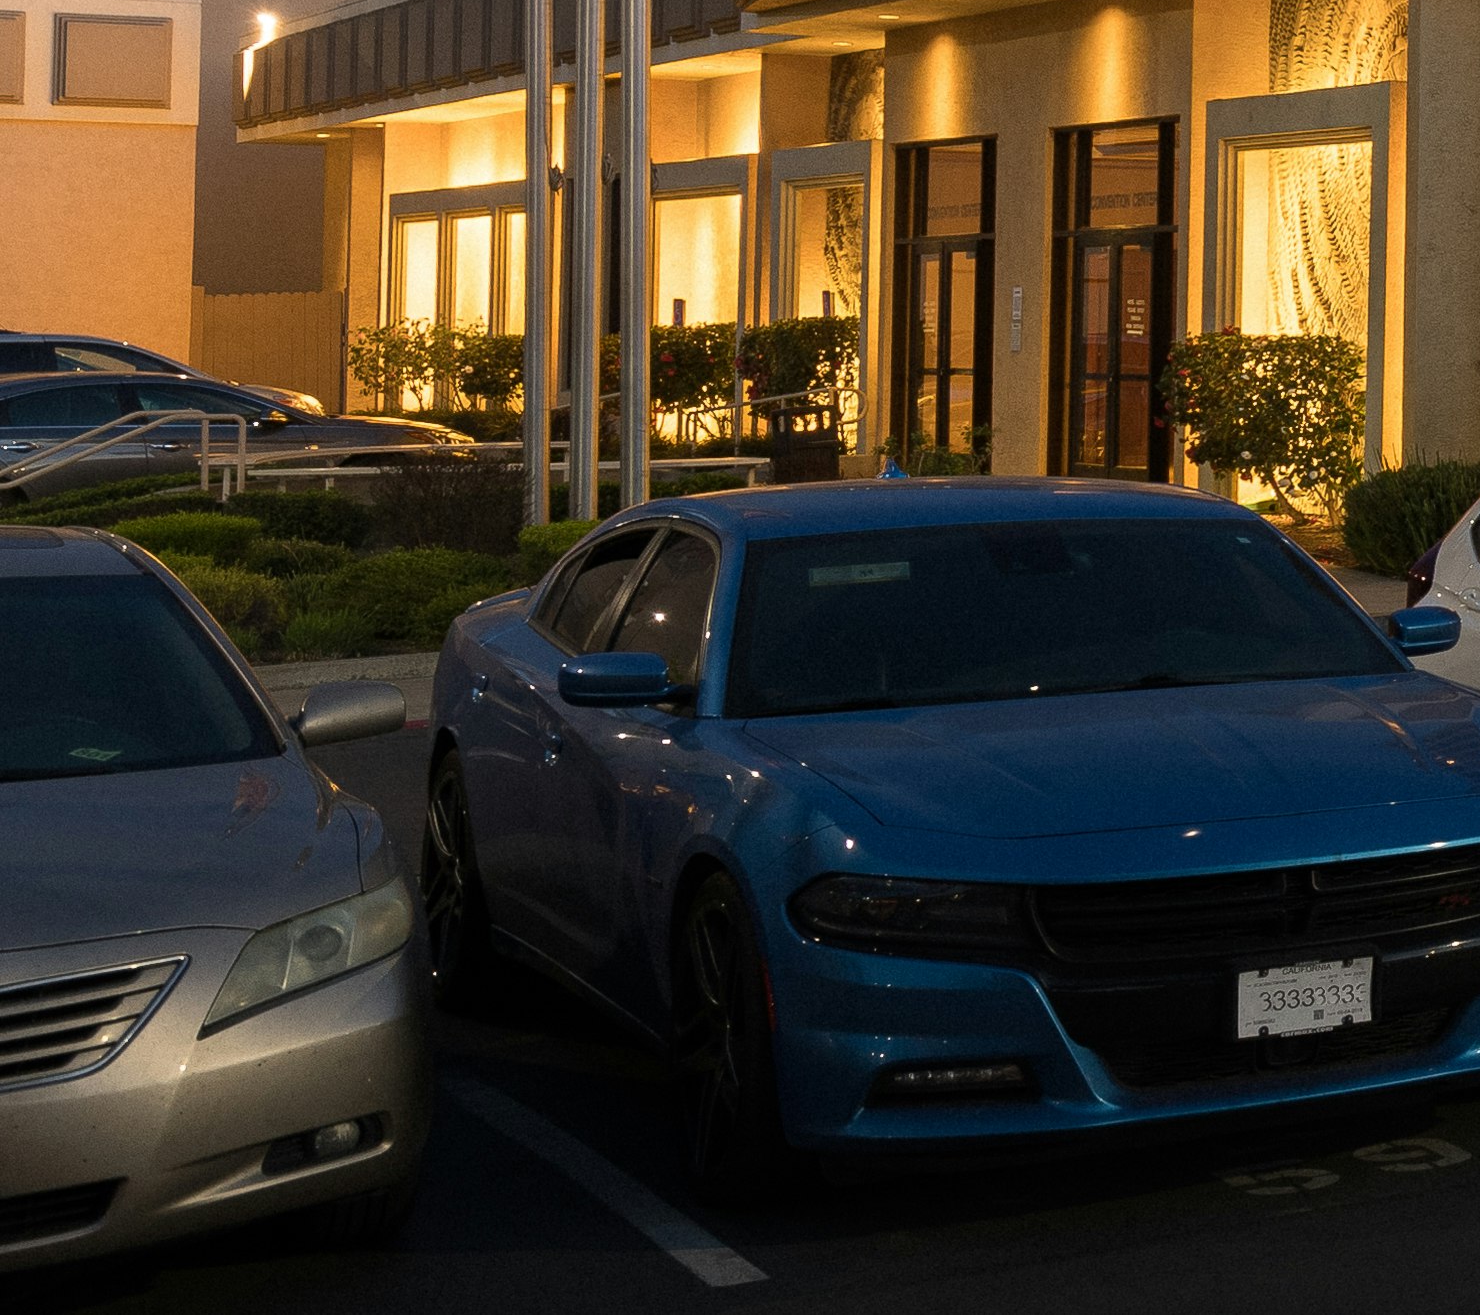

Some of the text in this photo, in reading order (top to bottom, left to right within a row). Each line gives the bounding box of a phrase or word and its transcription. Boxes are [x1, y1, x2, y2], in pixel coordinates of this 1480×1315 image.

[1281, 963, 1332, 976] CALIFORNIA
[1280, 1025, 1334, 1038] carmax.com
[1224, 1137, 1473, 1196] 59
